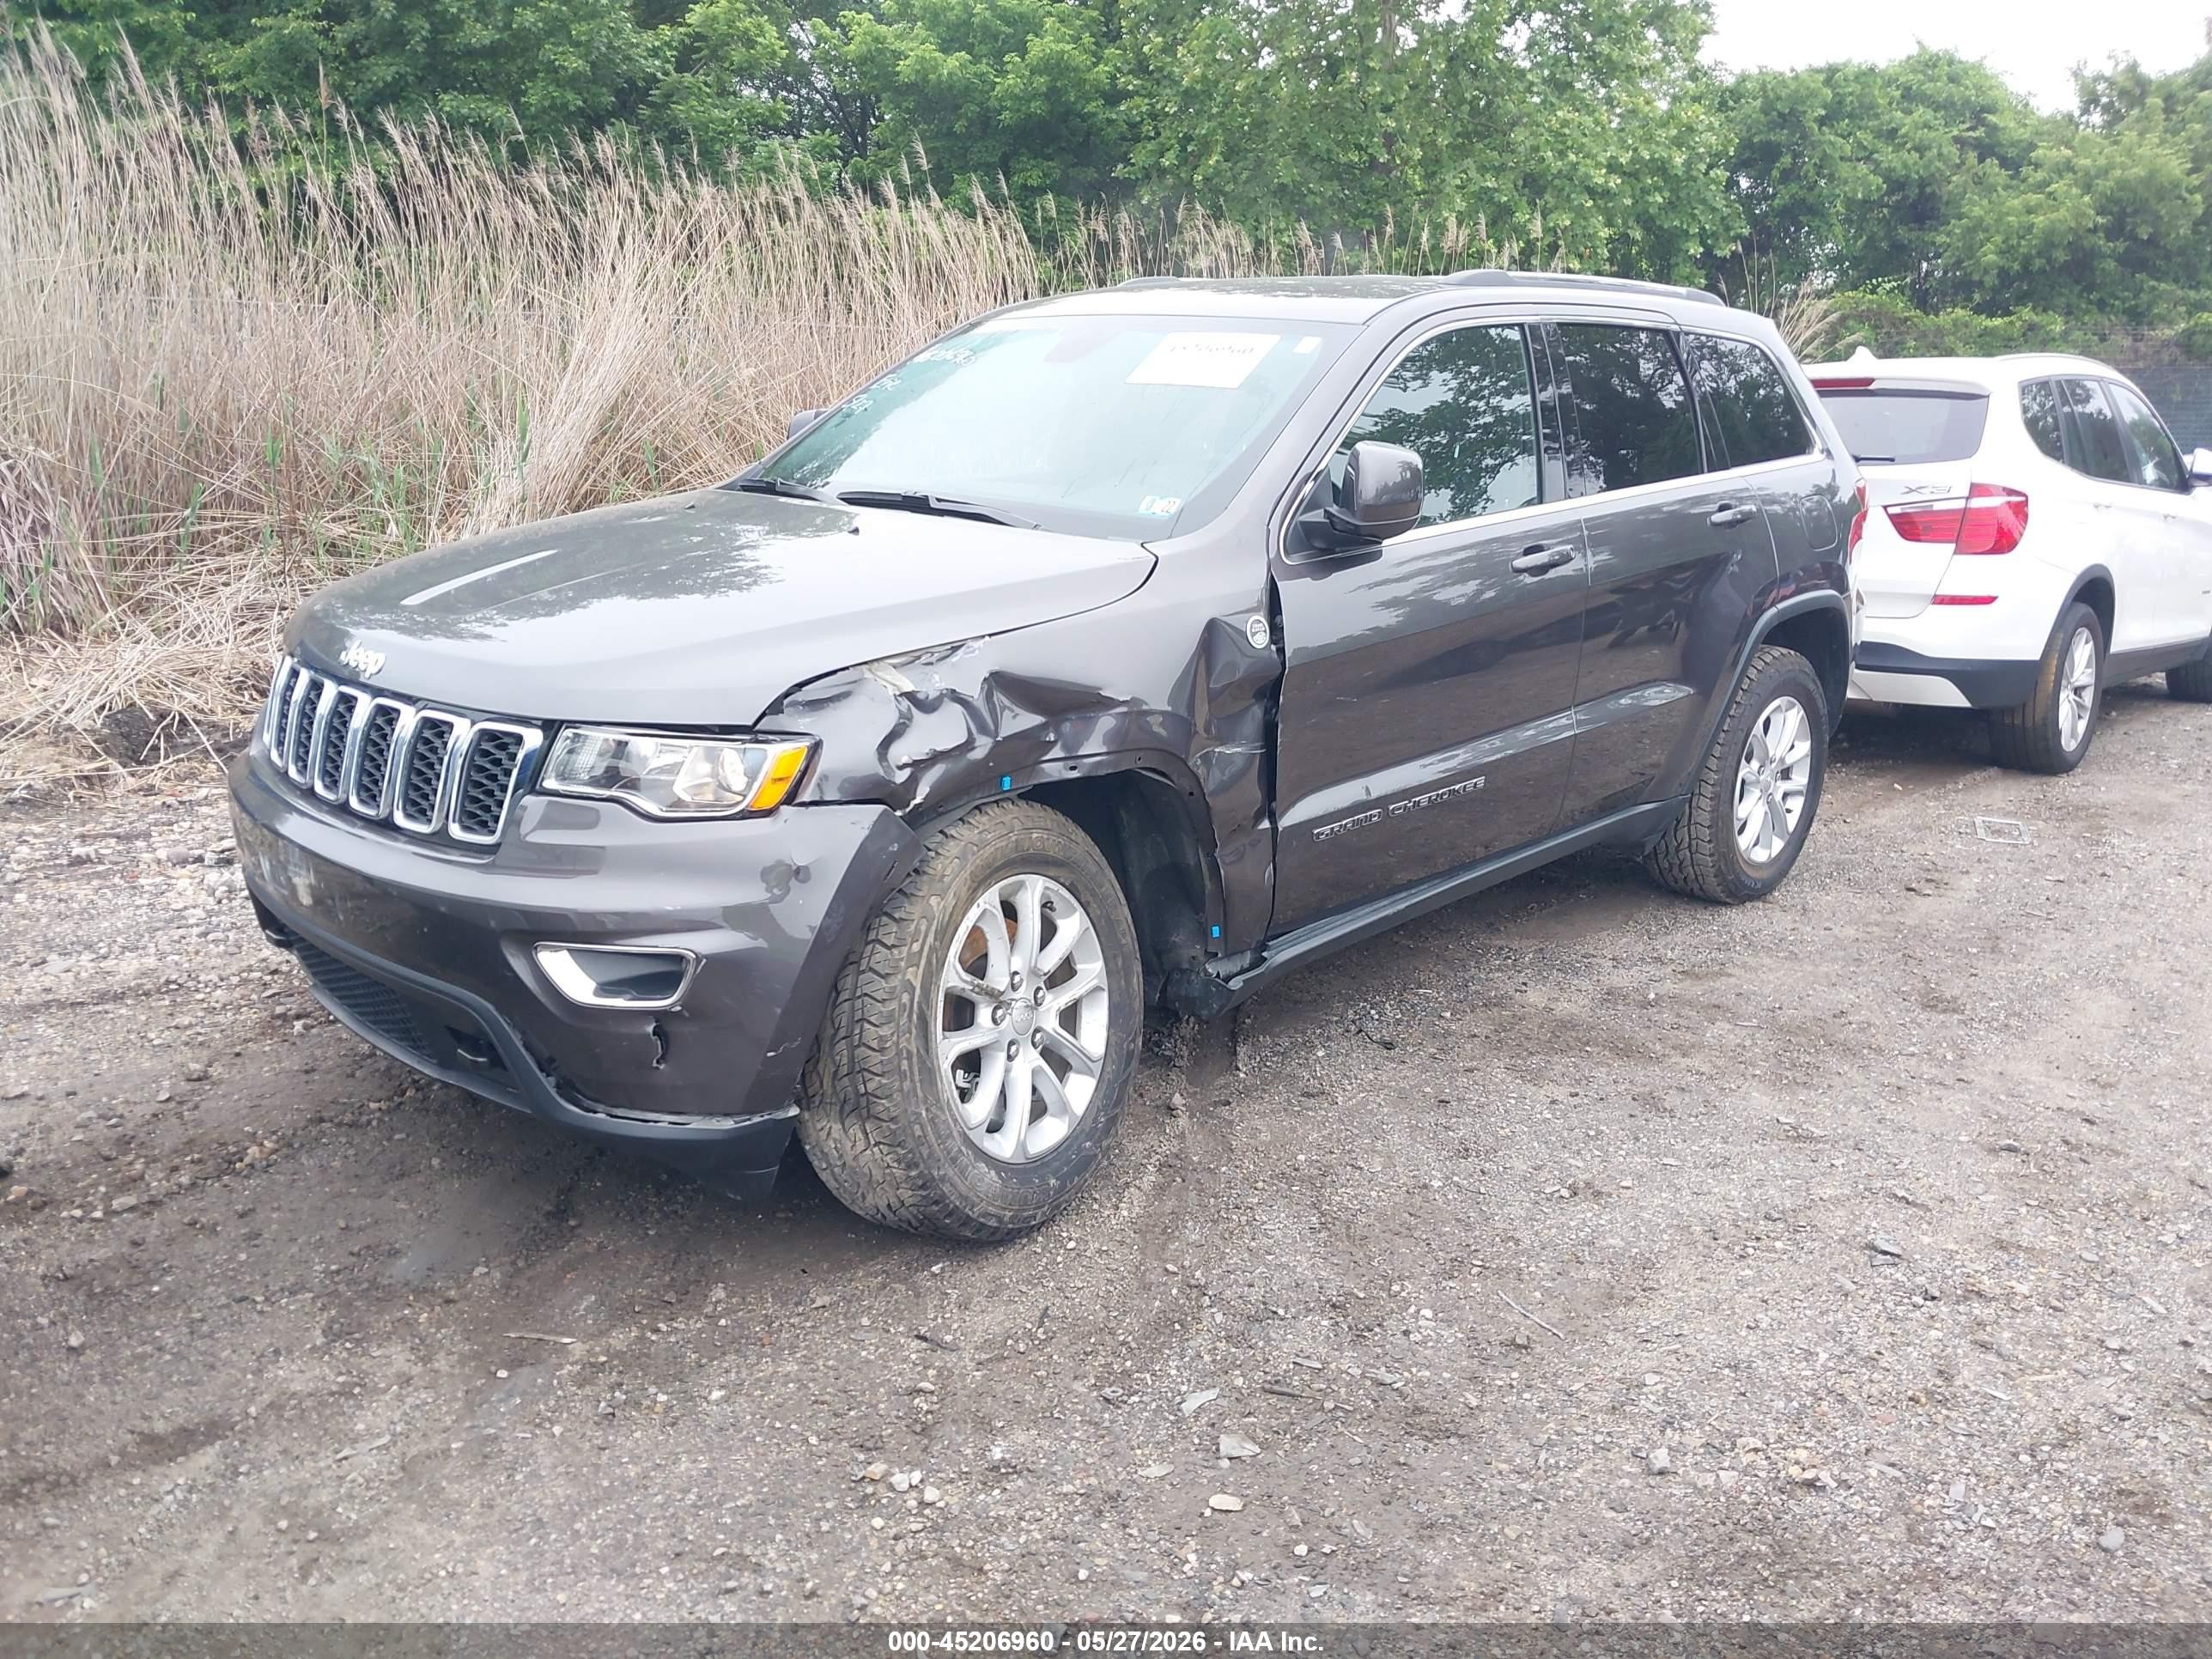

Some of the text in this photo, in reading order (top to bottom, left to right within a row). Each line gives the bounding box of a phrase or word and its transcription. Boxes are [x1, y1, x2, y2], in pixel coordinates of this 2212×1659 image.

[1900, 484, 1952, 495] X3
[339, 639, 386, 679] Jeep
[1312, 775, 1486, 842] GRAND CHEROKEE
